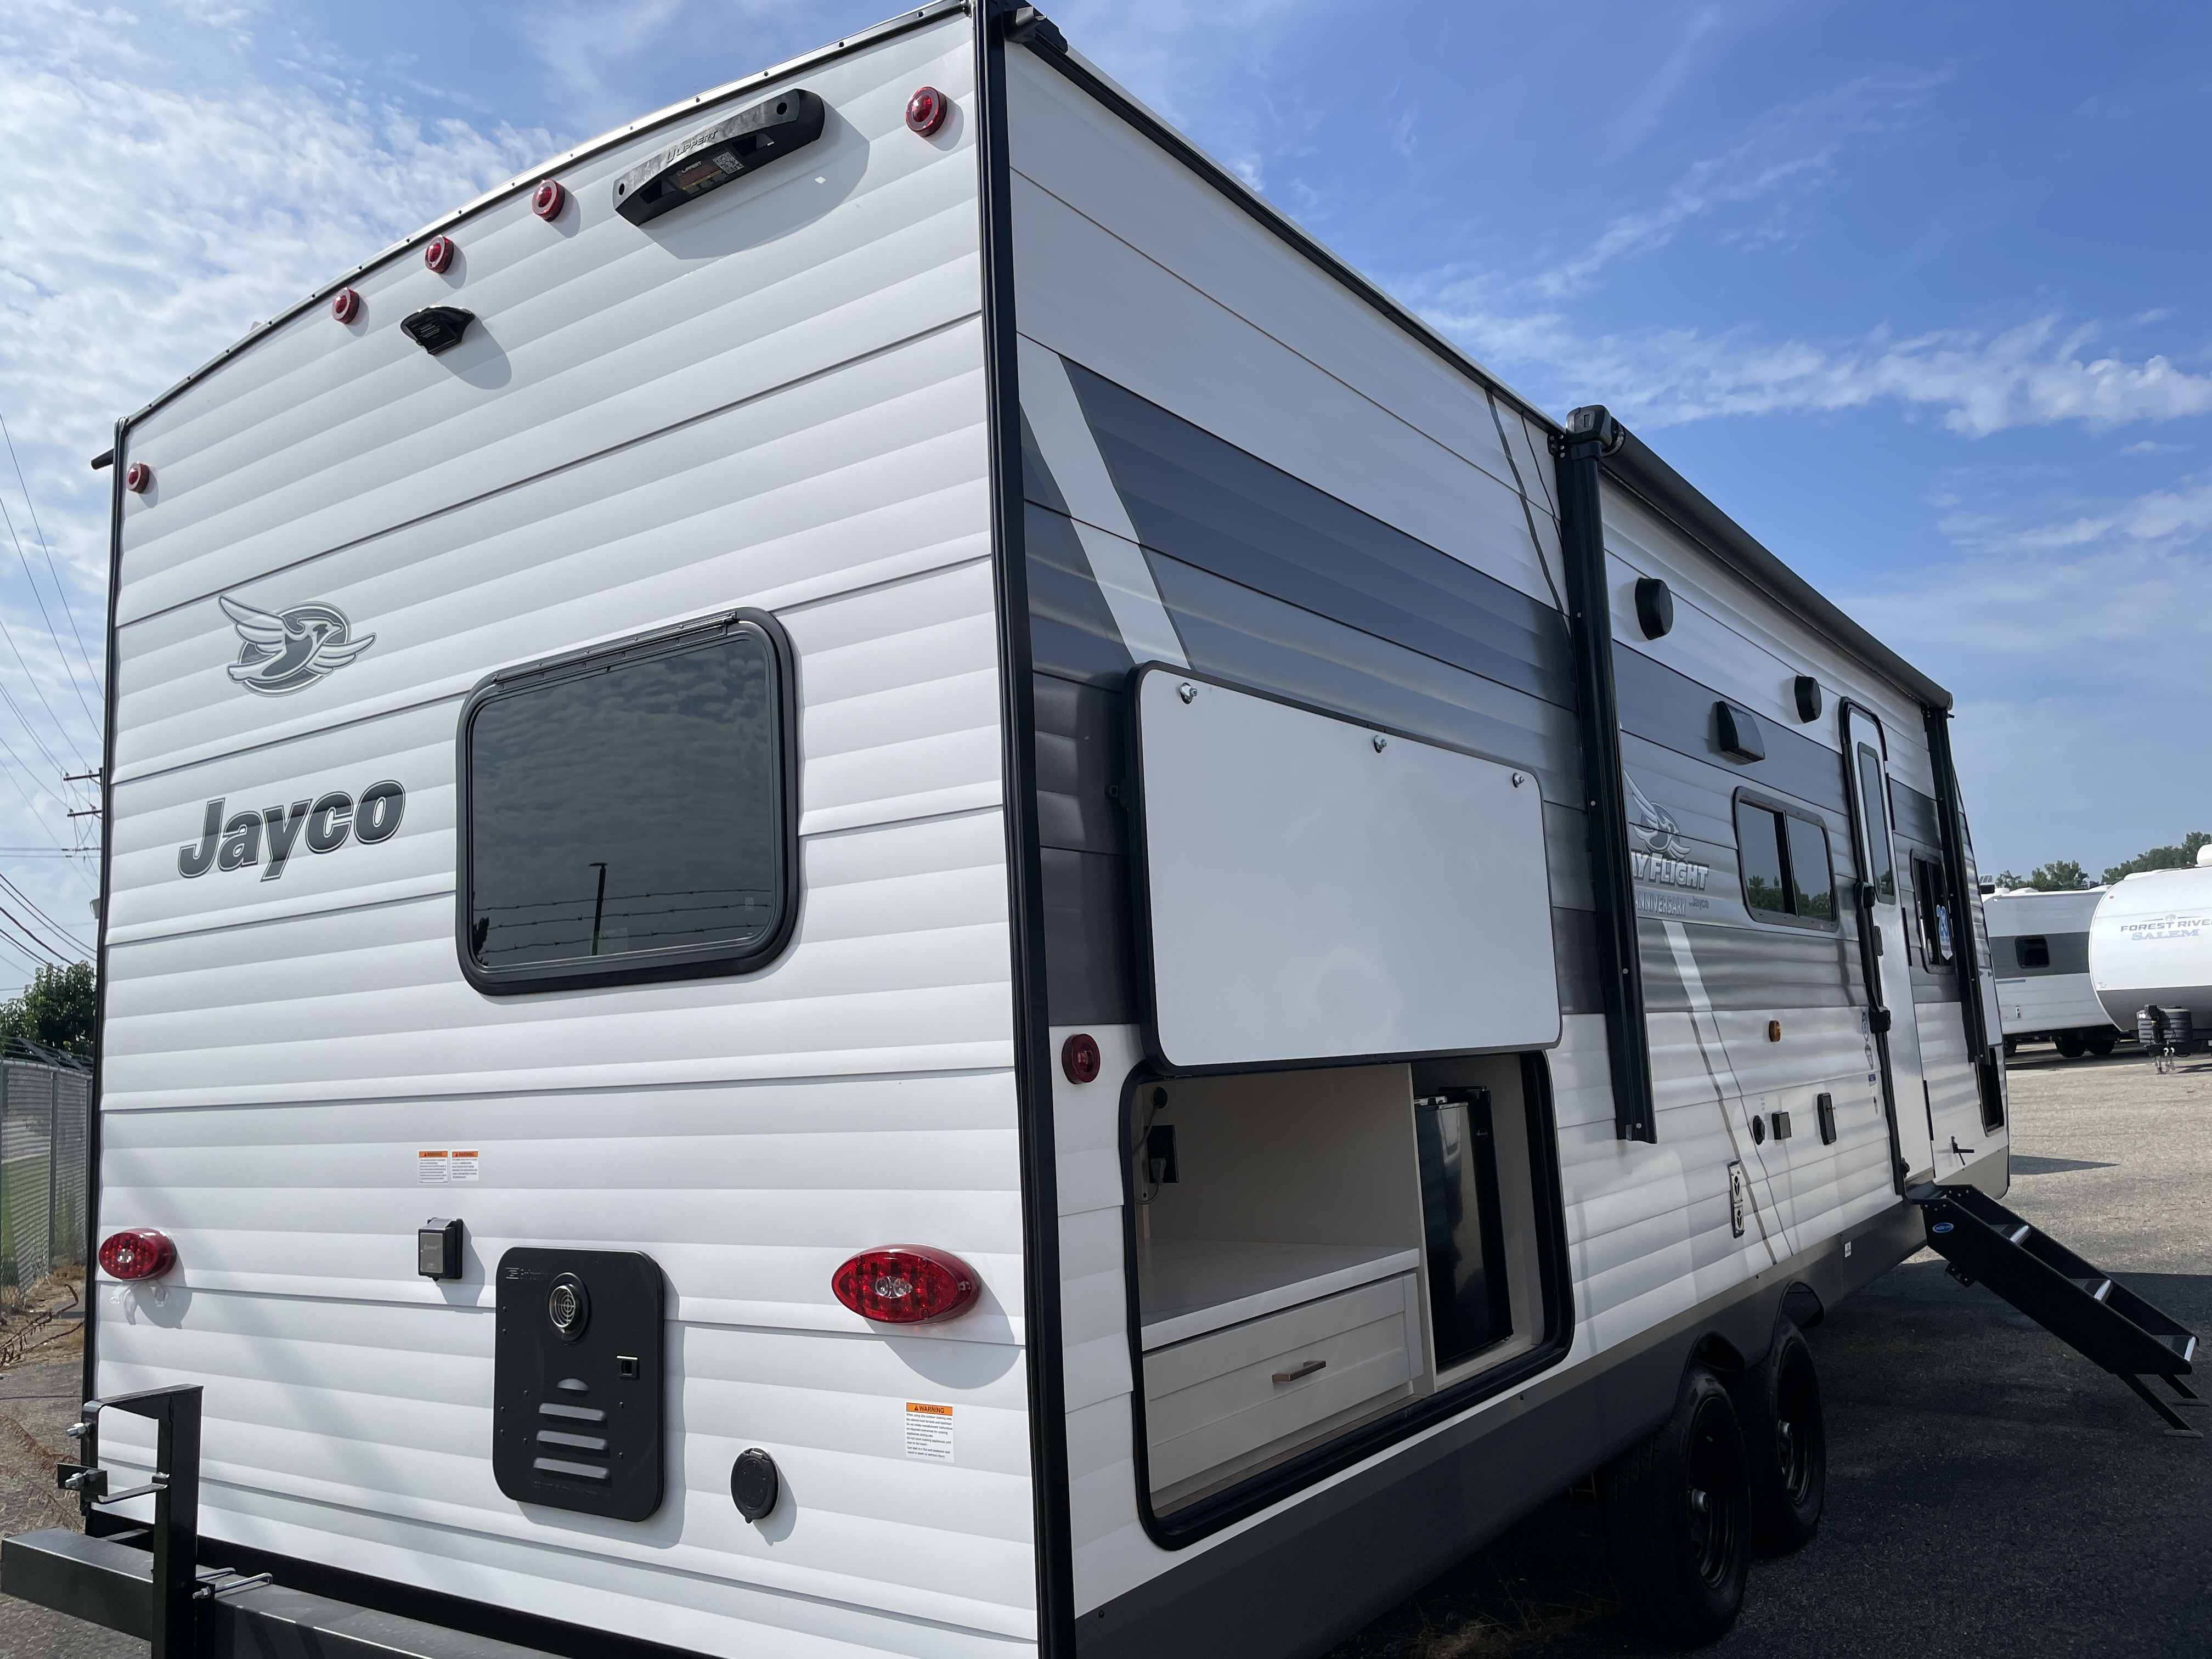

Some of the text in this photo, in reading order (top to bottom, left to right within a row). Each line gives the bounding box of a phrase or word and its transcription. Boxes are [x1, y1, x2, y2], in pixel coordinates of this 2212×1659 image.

[677, 131, 718, 156] LIPPERT
[178, 780, 405, 882] Jayco
[1649, 853, 1709, 891] FLIGHT
[2120, 918, 2212, 932] FOREST RIVE
[2131, 929, 2200, 940] SALEM
